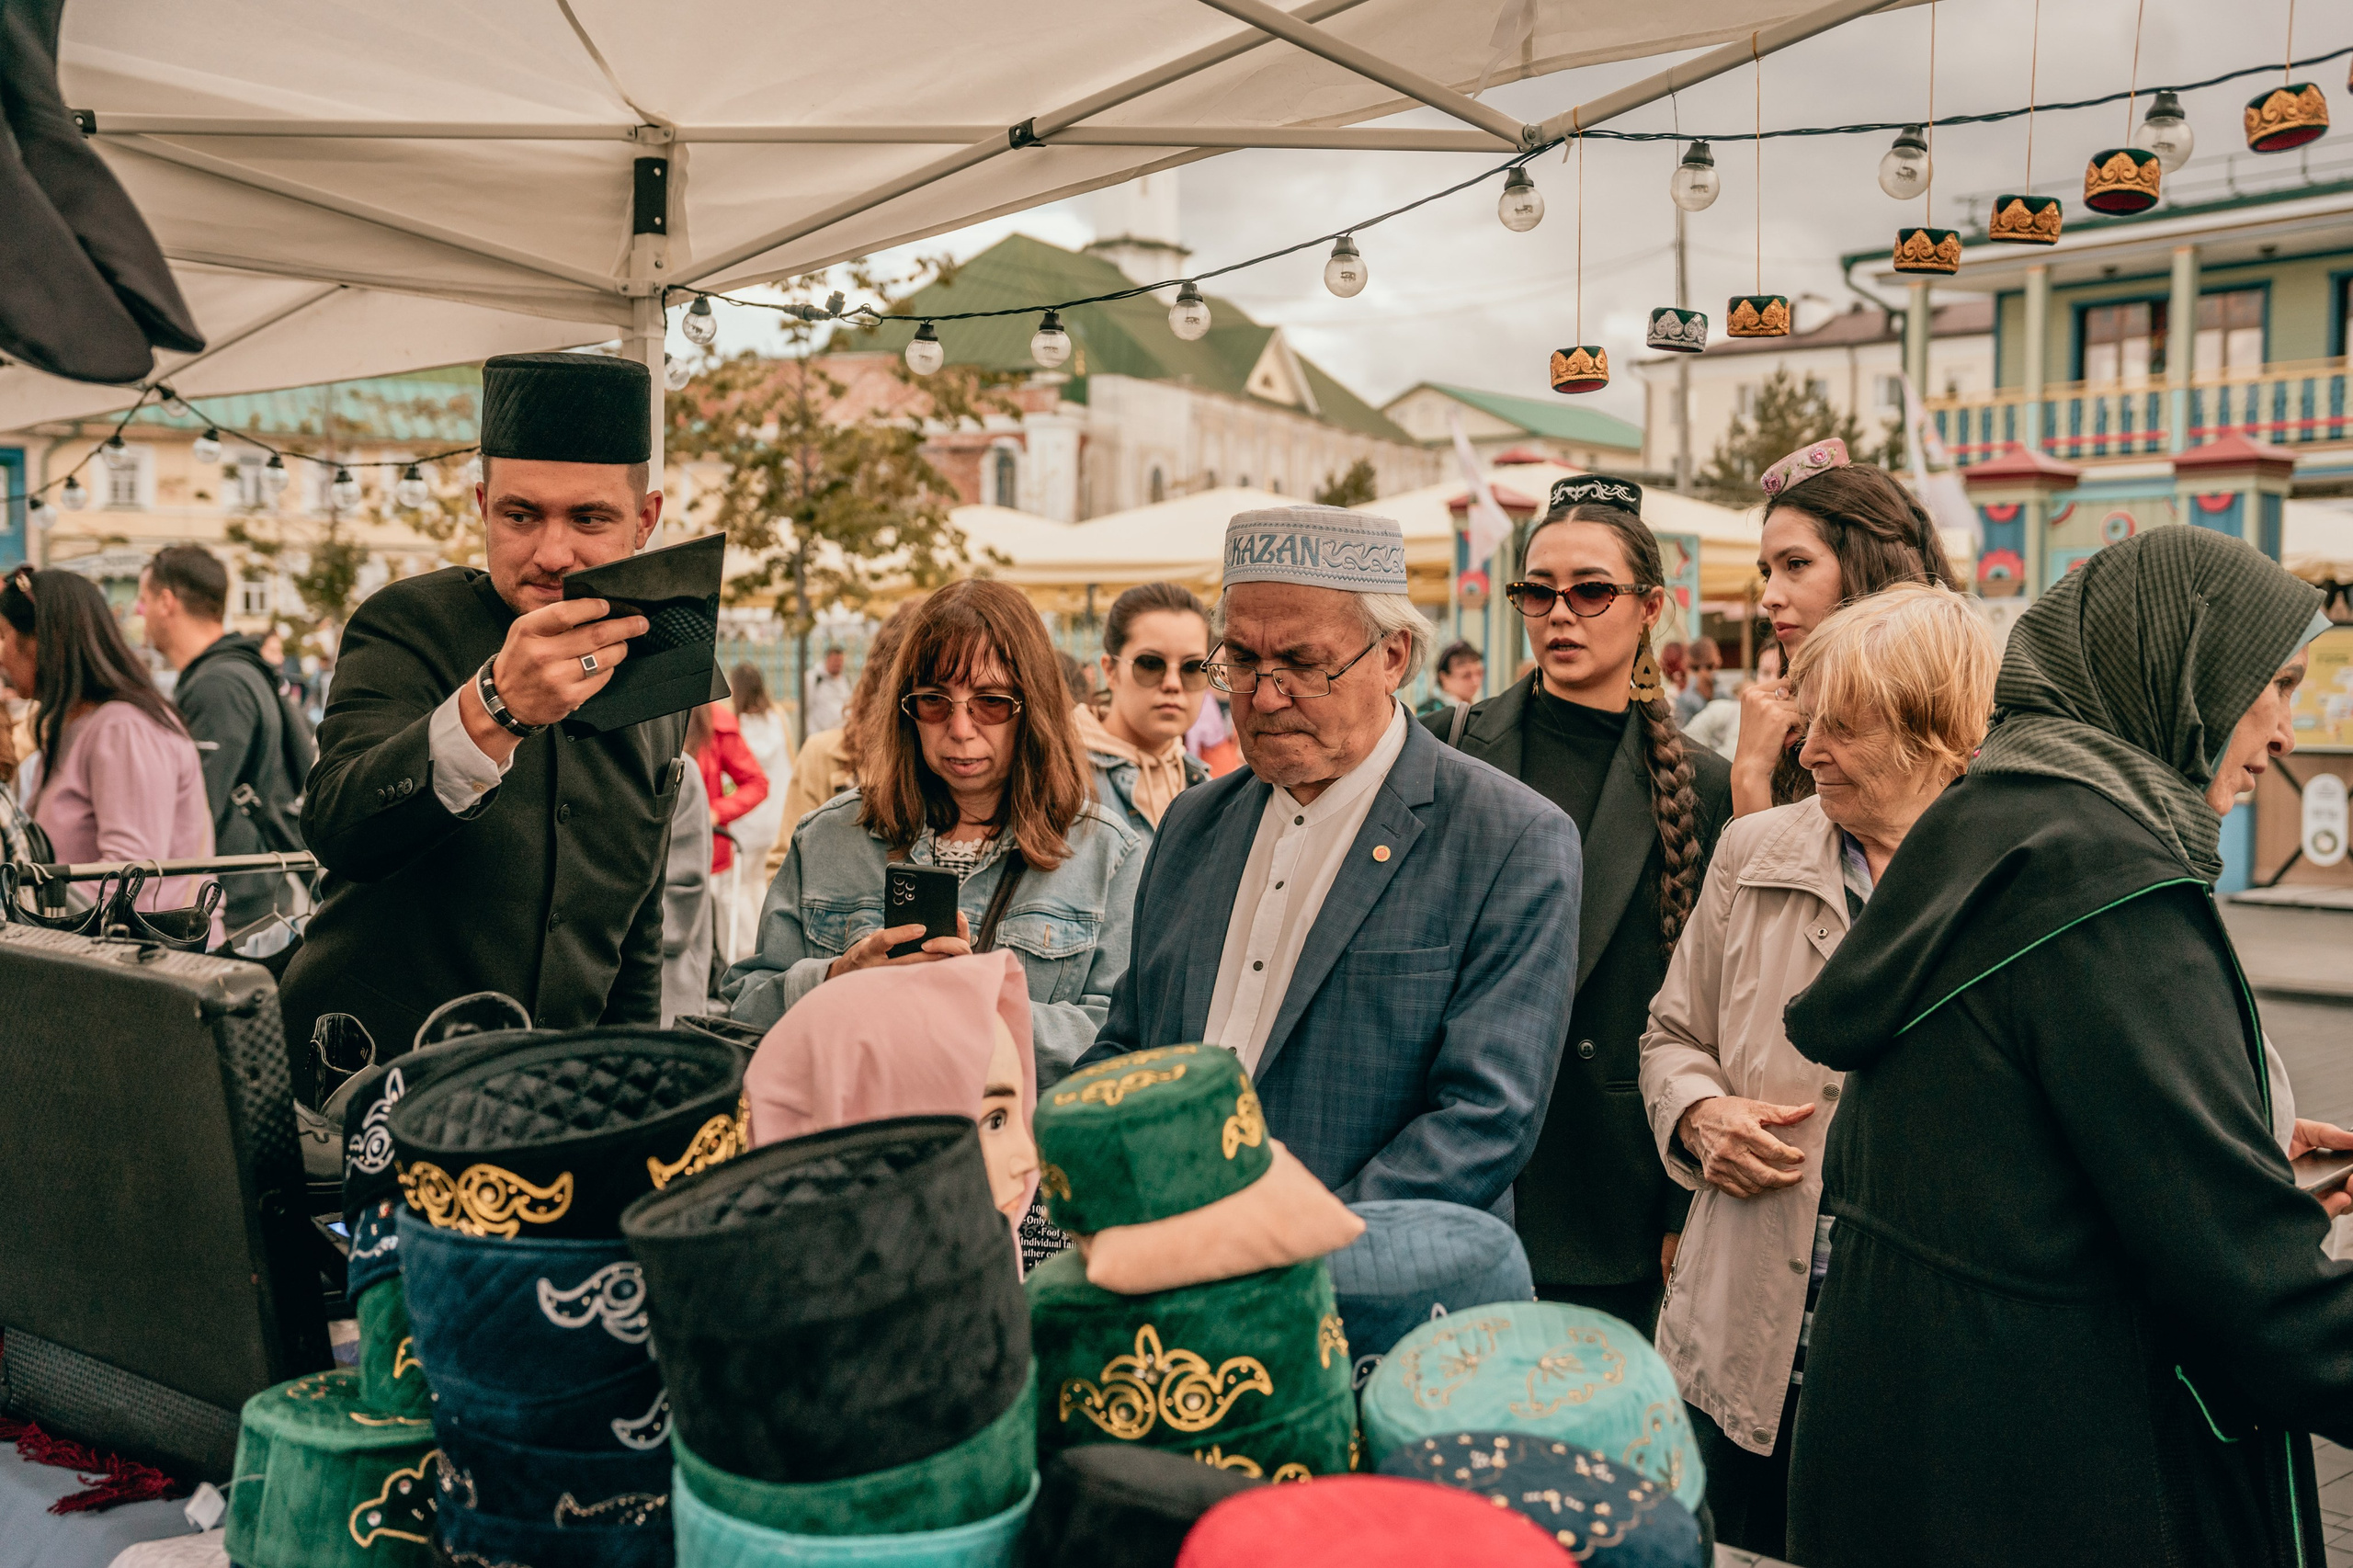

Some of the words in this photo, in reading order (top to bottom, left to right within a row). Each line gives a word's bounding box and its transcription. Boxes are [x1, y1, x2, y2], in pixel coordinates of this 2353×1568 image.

[1231, 534, 1321, 567] KAZAN
[1026, 1215, 1046, 1227] Only
[1040, 1227, 1060, 1237] Foot
[1020, 1237, 1062, 1248] Individual
[1022, 1248, 1046, 1258] ather
[1046, 1250, 1060, 1258] col
